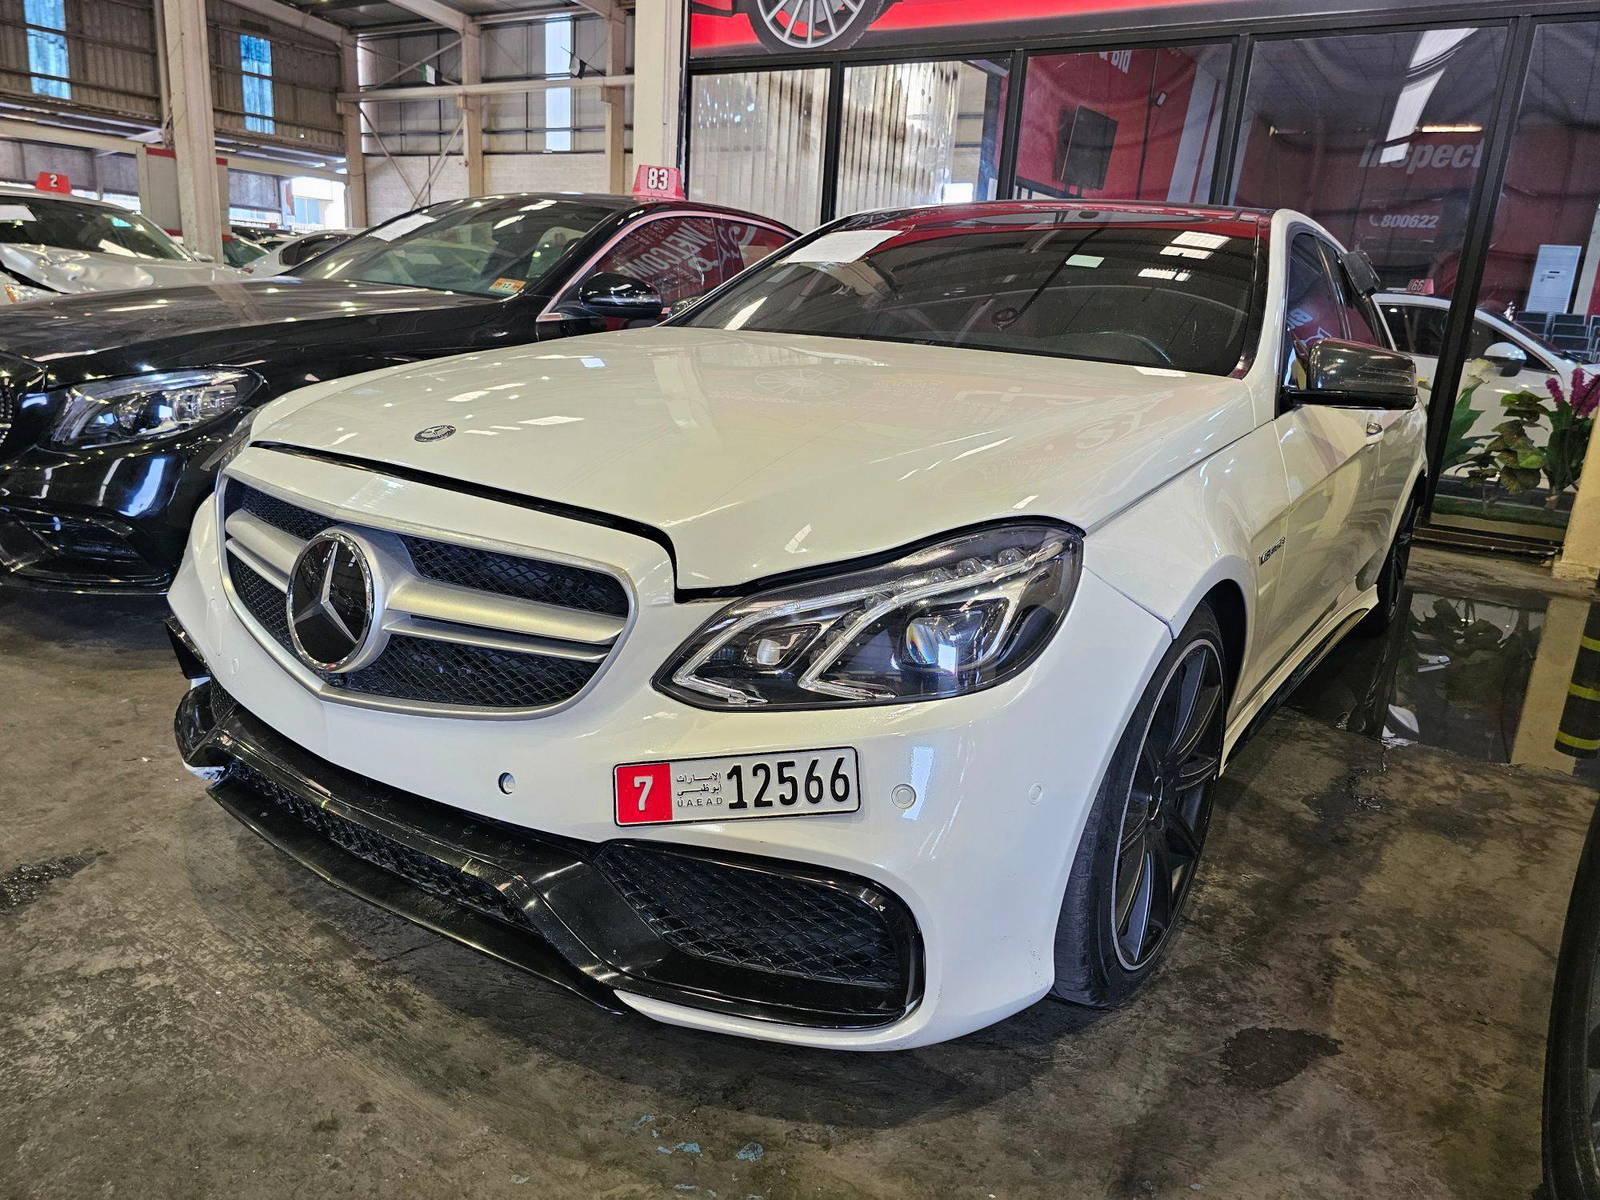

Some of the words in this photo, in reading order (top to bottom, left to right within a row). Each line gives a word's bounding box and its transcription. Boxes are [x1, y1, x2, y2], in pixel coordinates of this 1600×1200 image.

[49, 174, 58, 188] 2
[647, 167, 669, 191] 83
[633, 775, 654, 812] 7
[726, 756, 851, 810] 12566
